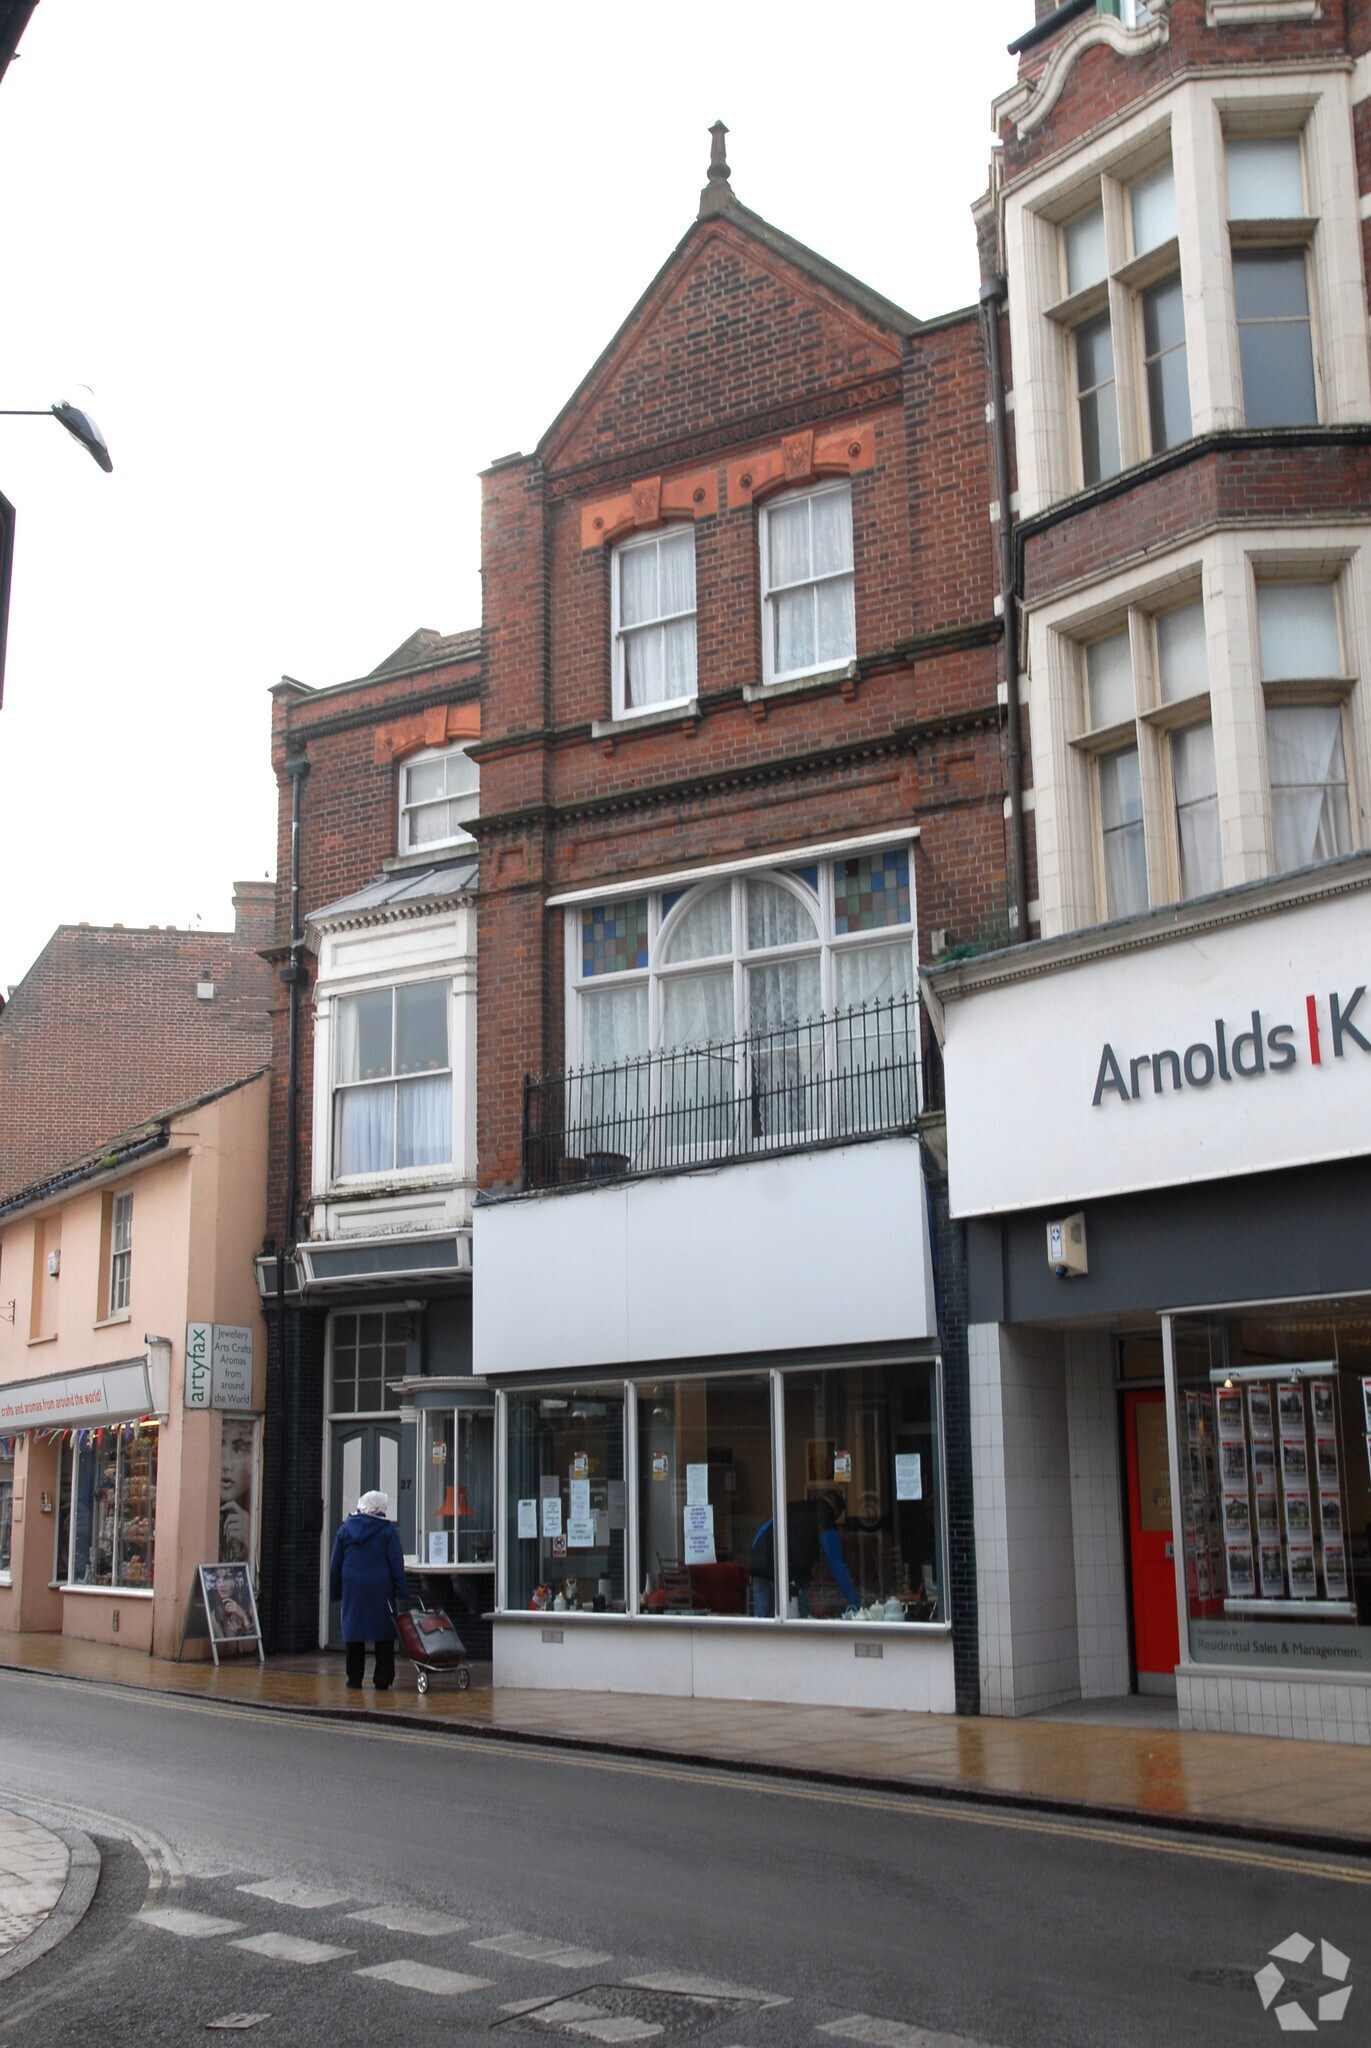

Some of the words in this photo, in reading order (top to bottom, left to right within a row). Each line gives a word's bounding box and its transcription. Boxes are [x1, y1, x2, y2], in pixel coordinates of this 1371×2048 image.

[1091, 1009, 1297, 1106] Arnolds
[217, 1328, 249, 1342] Jewellery
[214, 1342, 230, 1352] Arts
[231, 1343, 252, 1354] Crafts
[187, 1329, 211, 1402] artyfax
[220, 1355, 246, 1366] Aromas
[225, 1368, 241, 1378] from
[220, 1381, 245, 1390] around
[214, 1393, 226, 1402] the
[228, 1394, 250, 1404] World
[1, 1404, 14, 1417] crafts
[15, 1402, 24, 1415] and
[24, 1401, 42, 1414] aromas
[42, 1398, 55, 1410] from
[55, 1394, 75, 1409] around
[75, 1393, 84, 1405] the
[400, 1479, 412, 1490] 27
[1198, 1637, 1250, 1654] Residential
[1253, 1640, 1278, 1655] Sales
[1281, 1642, 1290, 1655] &
